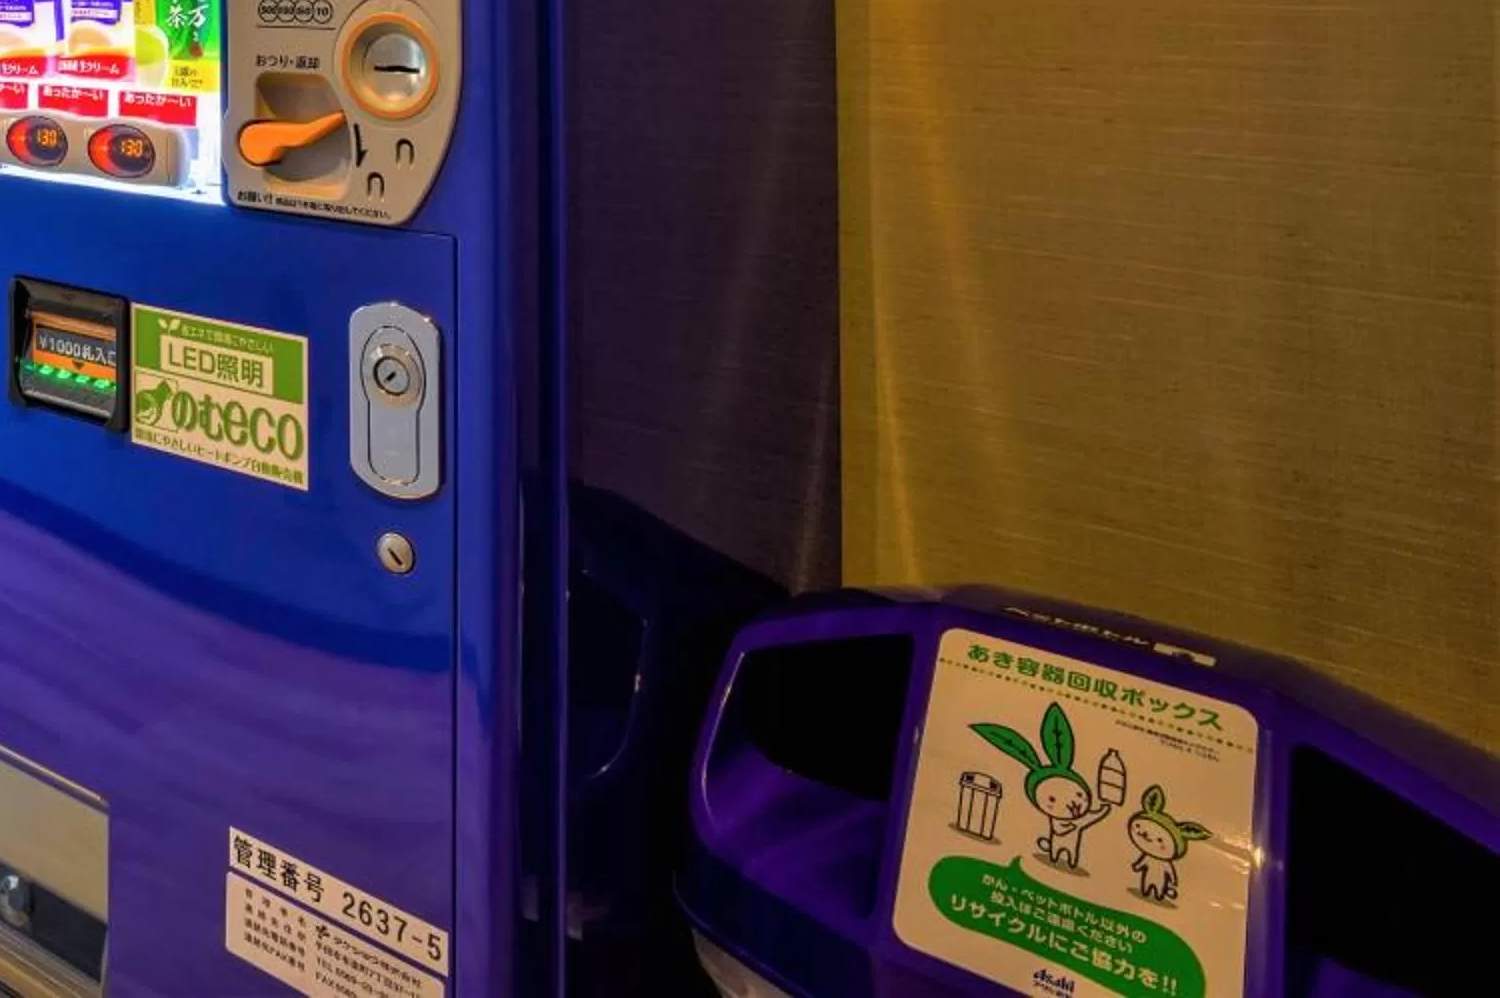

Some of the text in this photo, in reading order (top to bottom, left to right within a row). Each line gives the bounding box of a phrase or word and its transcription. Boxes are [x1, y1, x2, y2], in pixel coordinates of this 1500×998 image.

[167, 341, 264, 389] LED照明
[966, 642, 1224, 732] あき容器回収ボックス
[232, 834, 325, 904] 管理番号
[341, 890, 443, 963] 2637-5
[1032, 968, 1076, 995] Asahi
